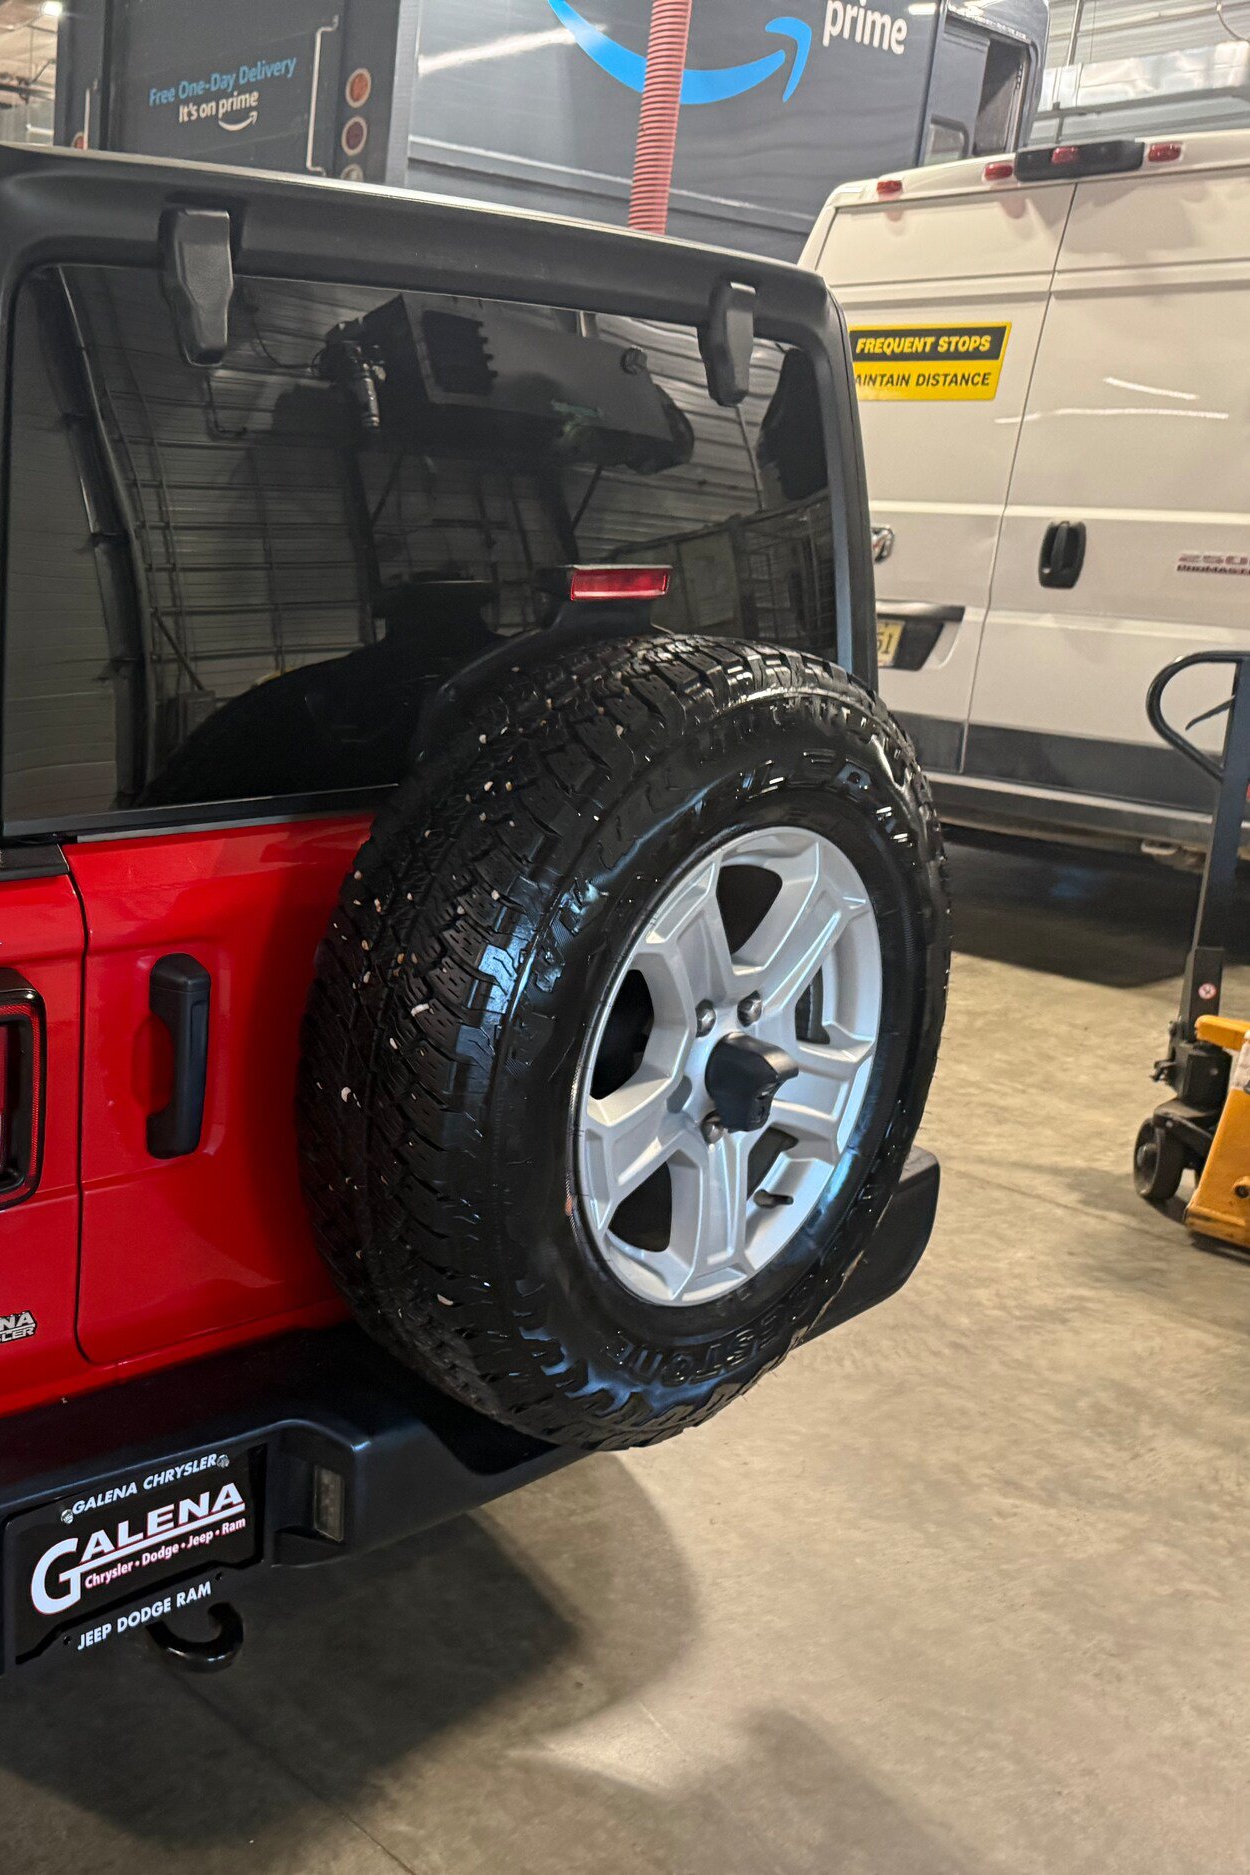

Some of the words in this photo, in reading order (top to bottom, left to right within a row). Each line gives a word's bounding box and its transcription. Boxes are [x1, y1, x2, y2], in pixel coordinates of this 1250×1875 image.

[822, 0, 908, 55] prime
[150, 87, 175, 107] Free
[178, 72, 237, 99] One-Day
[239, 57, 297, 83] Delivery
[178, 103, 198, 124] It's
[199, 102, 217, 118] on
[218, 90, 259, 118] prime
[855, 336, 935, 356] FREQUENT
[937, 335, 992, 353] STOPS
[855, 373, 911, 388] AINTAIN
[915, 372, 992, 387] DISTANCE
[72, 1482, 138, 1516] GALENA
[142, 1453, 218, 1491] CHRYSLER
[30, 1482, 246, 1616] GALENA
[84, 1559, 134, 1589] Chrysler
[141, 1542, 180, 1566] Dodge
[186, 1529, 214, 1550] Jeep
[221, 1517, 247, 1536] Ram
[77, 1623, 112, 1651] JEEP
[117, 1597, 172, 1634] DODGE
[176, 1581, 212, 1609] RAM
